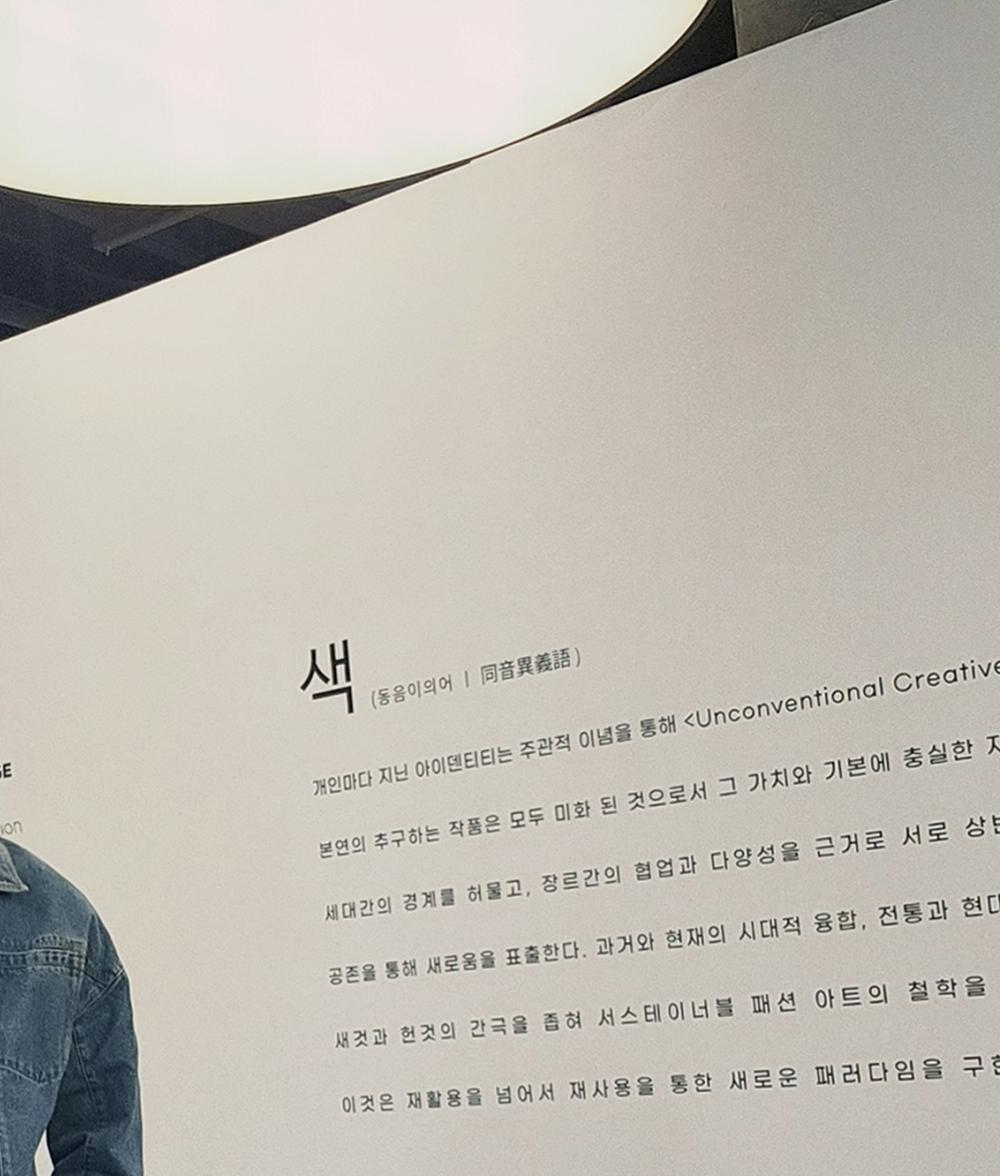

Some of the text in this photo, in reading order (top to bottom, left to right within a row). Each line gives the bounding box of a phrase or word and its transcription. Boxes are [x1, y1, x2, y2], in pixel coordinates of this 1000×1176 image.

[300, 639, 354, 714] 색
[371, 674, 453, 709] (동음이의어
[312, 770, 373, 796] 개인마다
[378, 763, 409, 785] 지닌
[414, 746, 513, 778] 아이덴티티는
[519, 733, 572, 760] 주관적
[578, 722, 632, 749] 이념을
[640, 714, 677, 739] 통해
[319, 836, 366, 860] 본연의
[374, 826, 440, 850] 추구하는
[448, 814, 501, 838] 작품은
[509, 807, 545, 830] 모두
[554, 799, 591, 822] 미화
[600, 795, 618, 816] 된
[627, 780, 708, 812] 것으로서
[718, 776, 738, 797] 그
[747, 764, 813, 793] 가치와
[823, 751, 891, 781] 기본에
[903, 738, 974, 769] 충실한
[325, 896, 392, 921] 세대간의
[402, 887, 455, 912] 경계를
[466, 878, 531, 903] 허물고,
[541, 864, 621, 893] 장르간의
[633, 854, 697, 882] 협업과
[710, 841, 800, 871] 다양성을
[815, 830, 886, 858] 근거로
[902, 821, 950, 846] 서로
[328, 963, 377, 986] 공존을
[385, 958, 418, 980] 통해
[426, 950, 496, 974] 새로움을
[505, 940, 587, 966] 표출한다.
[596, 931, 655, 956] 과거와
[665, 923, 726, 950] 현재의
[738, 915, 802, 941] 시대적
[813, 909, 866, 934] 융합,
[877, 899, 949, 927] 전통과
[335, 975, 986, 1049] 새것과 헌것의 간극을 좁혀 서스테이너블 패션 아트의 철학을
[342, 1093, 394, 1114] 이것은
[406, 1087, 482, 1110] 재활용을
[495, 1082, 555, 1105] 넘어서
[568, 1076, 654, 1100] 재사용을
[670, 1072, 713, 1095] 통한
[729, 1067, 798, 1091] 새로운
[814, 1057, 944, 1086] 패러다임을
